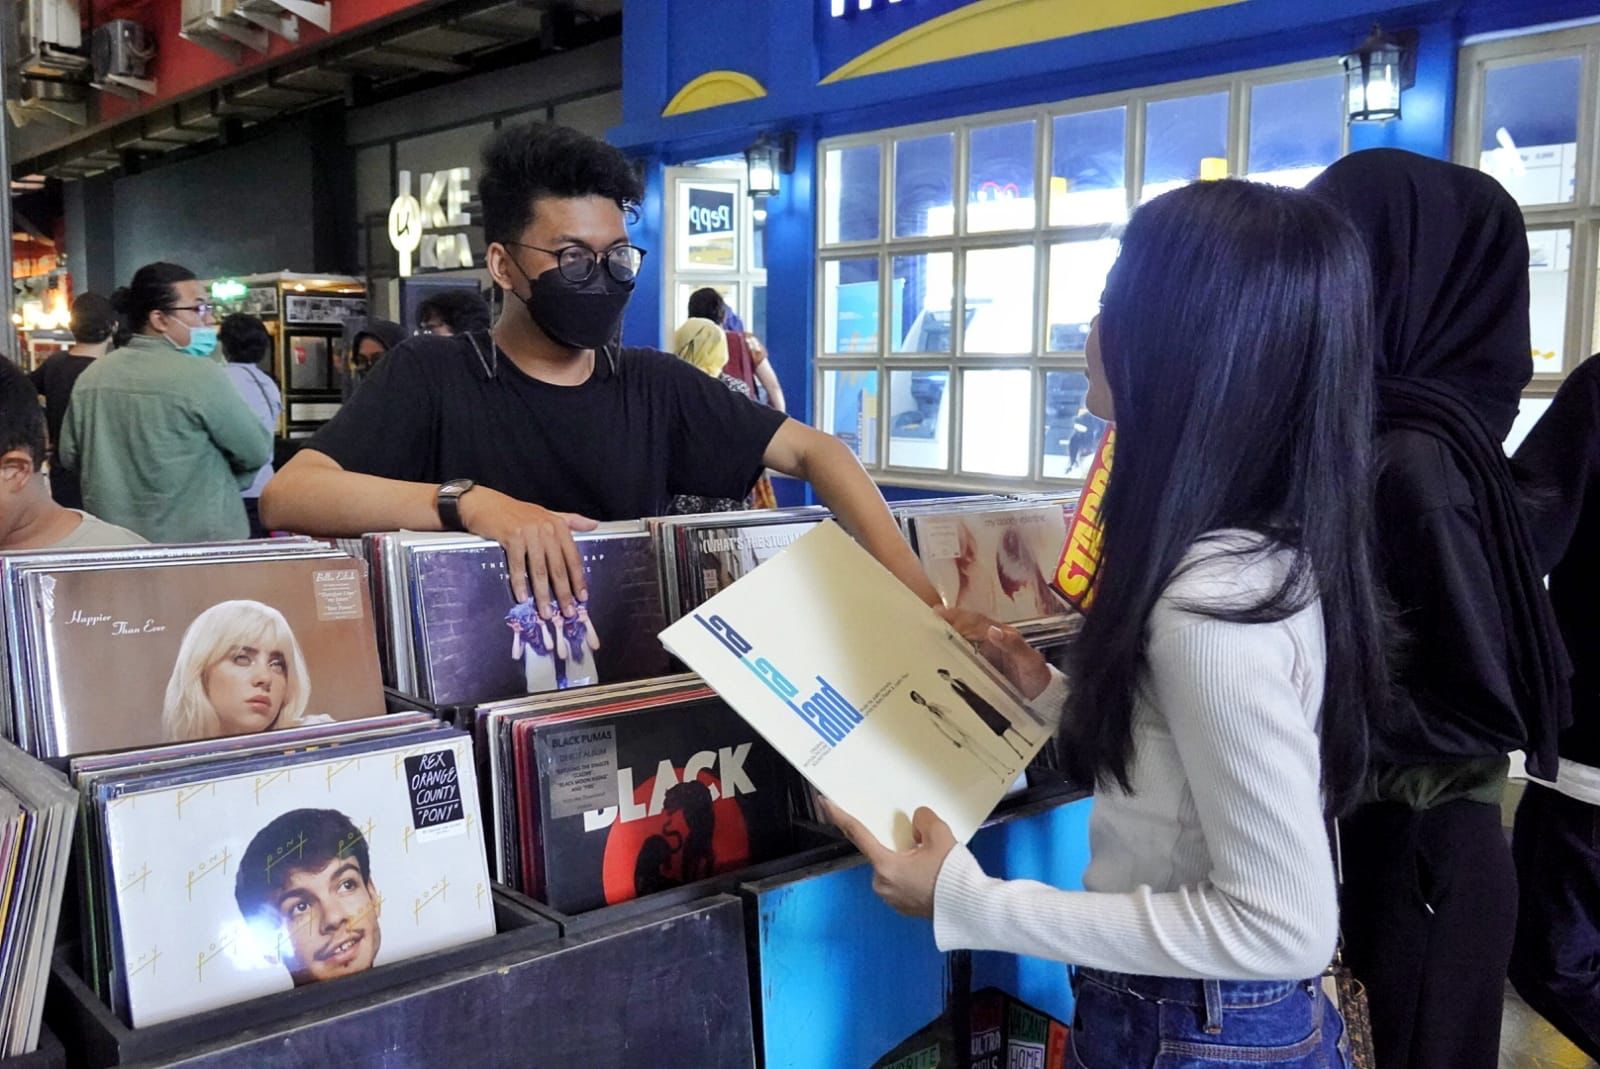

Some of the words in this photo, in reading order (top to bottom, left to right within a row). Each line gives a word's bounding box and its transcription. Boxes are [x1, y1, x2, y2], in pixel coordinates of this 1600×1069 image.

[64, 609, 112, 626] Happier
[112, 621, 141, 635] Than
[143, 618, 167, 632] Ever
[784, 674, 864, 748] land
[418, 751, 446, 772] REX
[411, 766, 458, 791] ORANGE
[416, 784, 457, 805] COUNTY
[971, 1030, 1001, 1055] ULTRA
[1010, 1047, 1040, 1069] HOME
